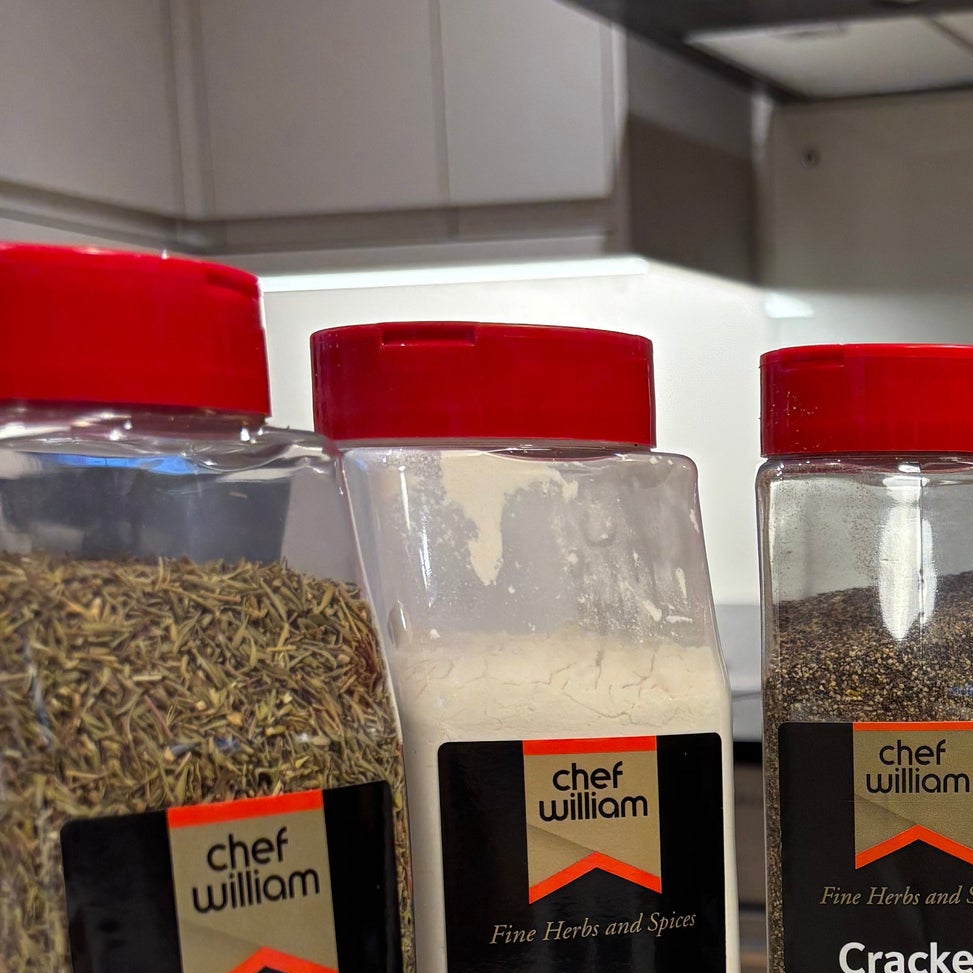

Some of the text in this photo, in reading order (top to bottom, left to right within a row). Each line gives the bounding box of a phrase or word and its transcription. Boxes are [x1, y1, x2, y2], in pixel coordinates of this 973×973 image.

[879, 739, 946, 766] chef
[552, 760, 624, 792] chef
[866, 768, 970, 794] william
[539, 792, 648, 821] william
[207, 826, 289, 871] chef
[192, 867, 320, 914] william
[820, 886, 861, 905] Fine
[867, 886, 920, 905] Herbs
[926, 886, 961, 905] and
[489, 911, 696, 945] Fine Herbs and Spices
